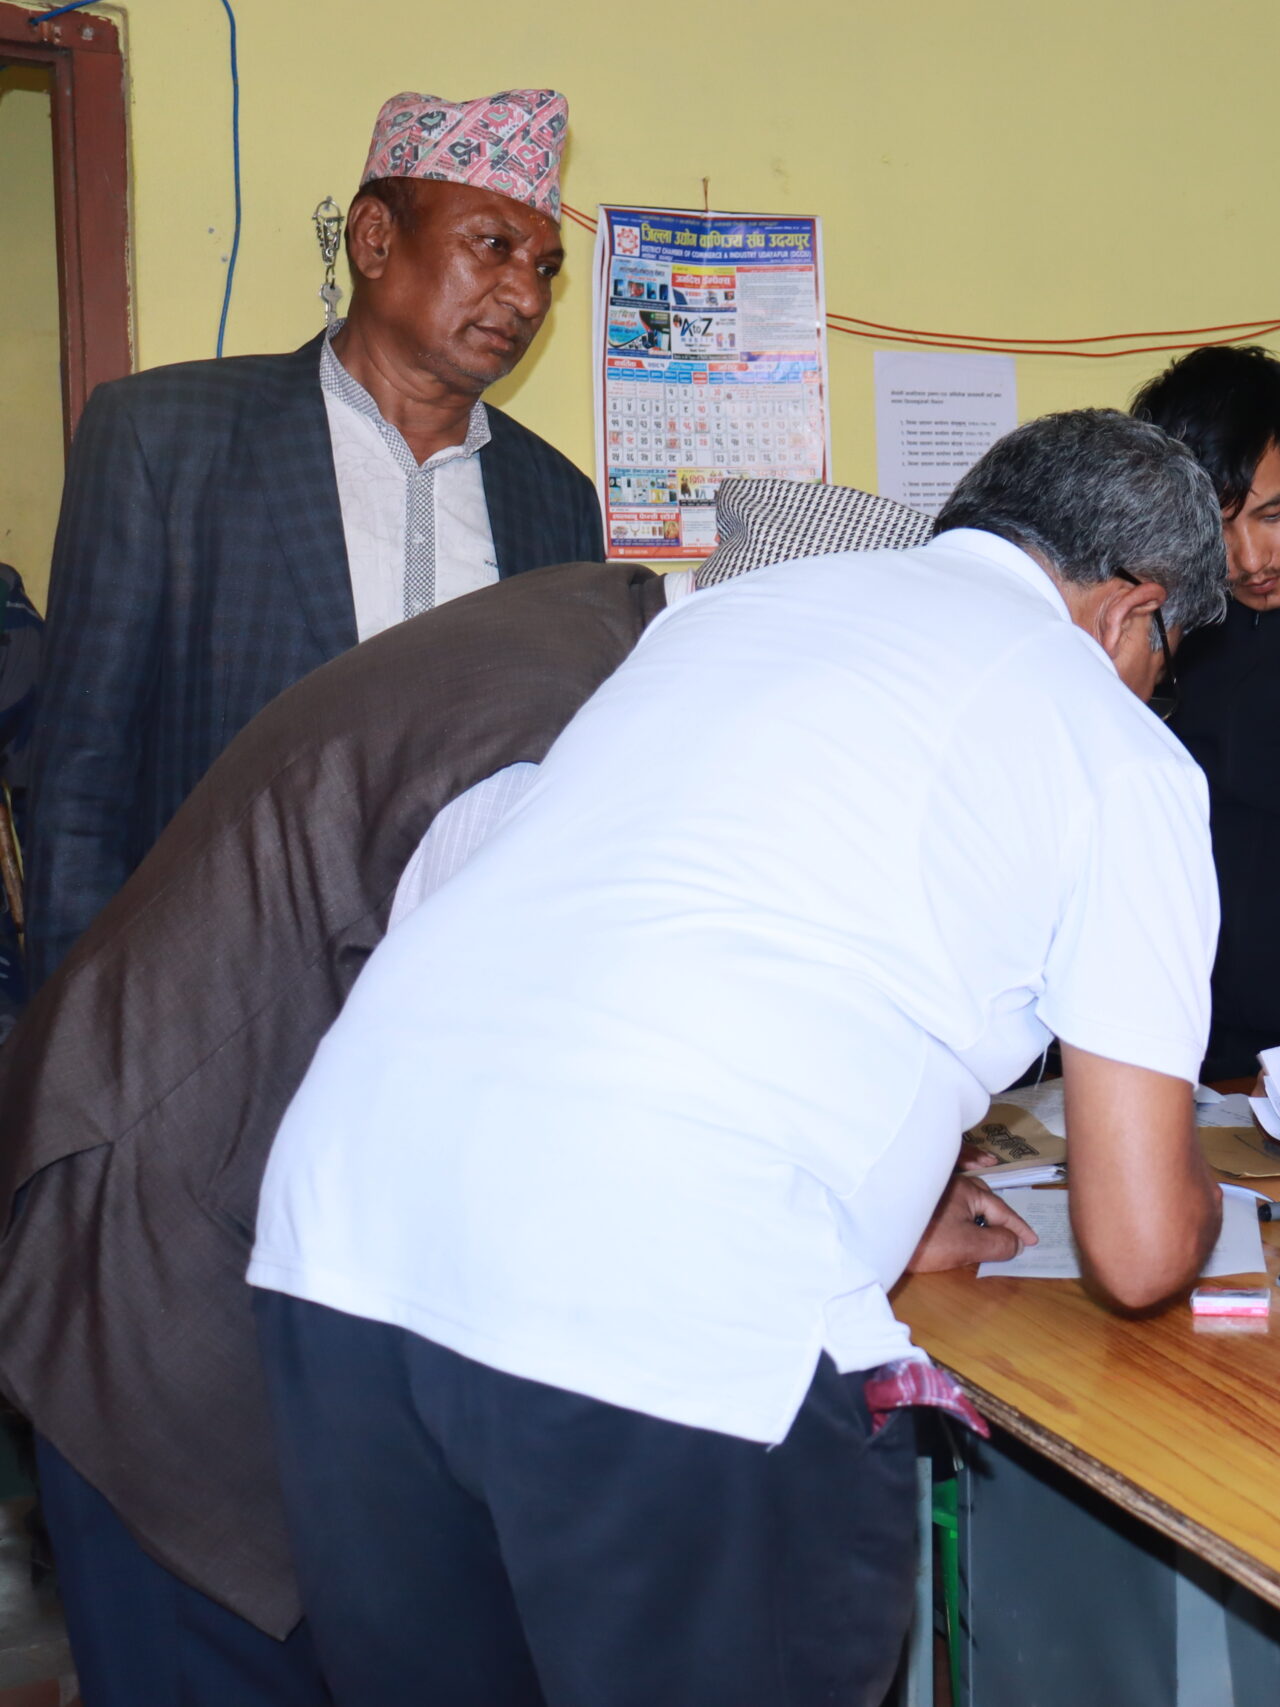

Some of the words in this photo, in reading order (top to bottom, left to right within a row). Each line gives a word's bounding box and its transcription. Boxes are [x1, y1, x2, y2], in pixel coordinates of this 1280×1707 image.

[641, 223, 672, 243] जिल्ला
[700, 230, 743, 249] वाणिज्य
[746, 231, 766, 248] संघ
[769, 233, 810, 250] उदयपुर
[684, 250, 691, 258] OF
[692, 325, 701, 333] to
[700, 318, 713, 336] Z
